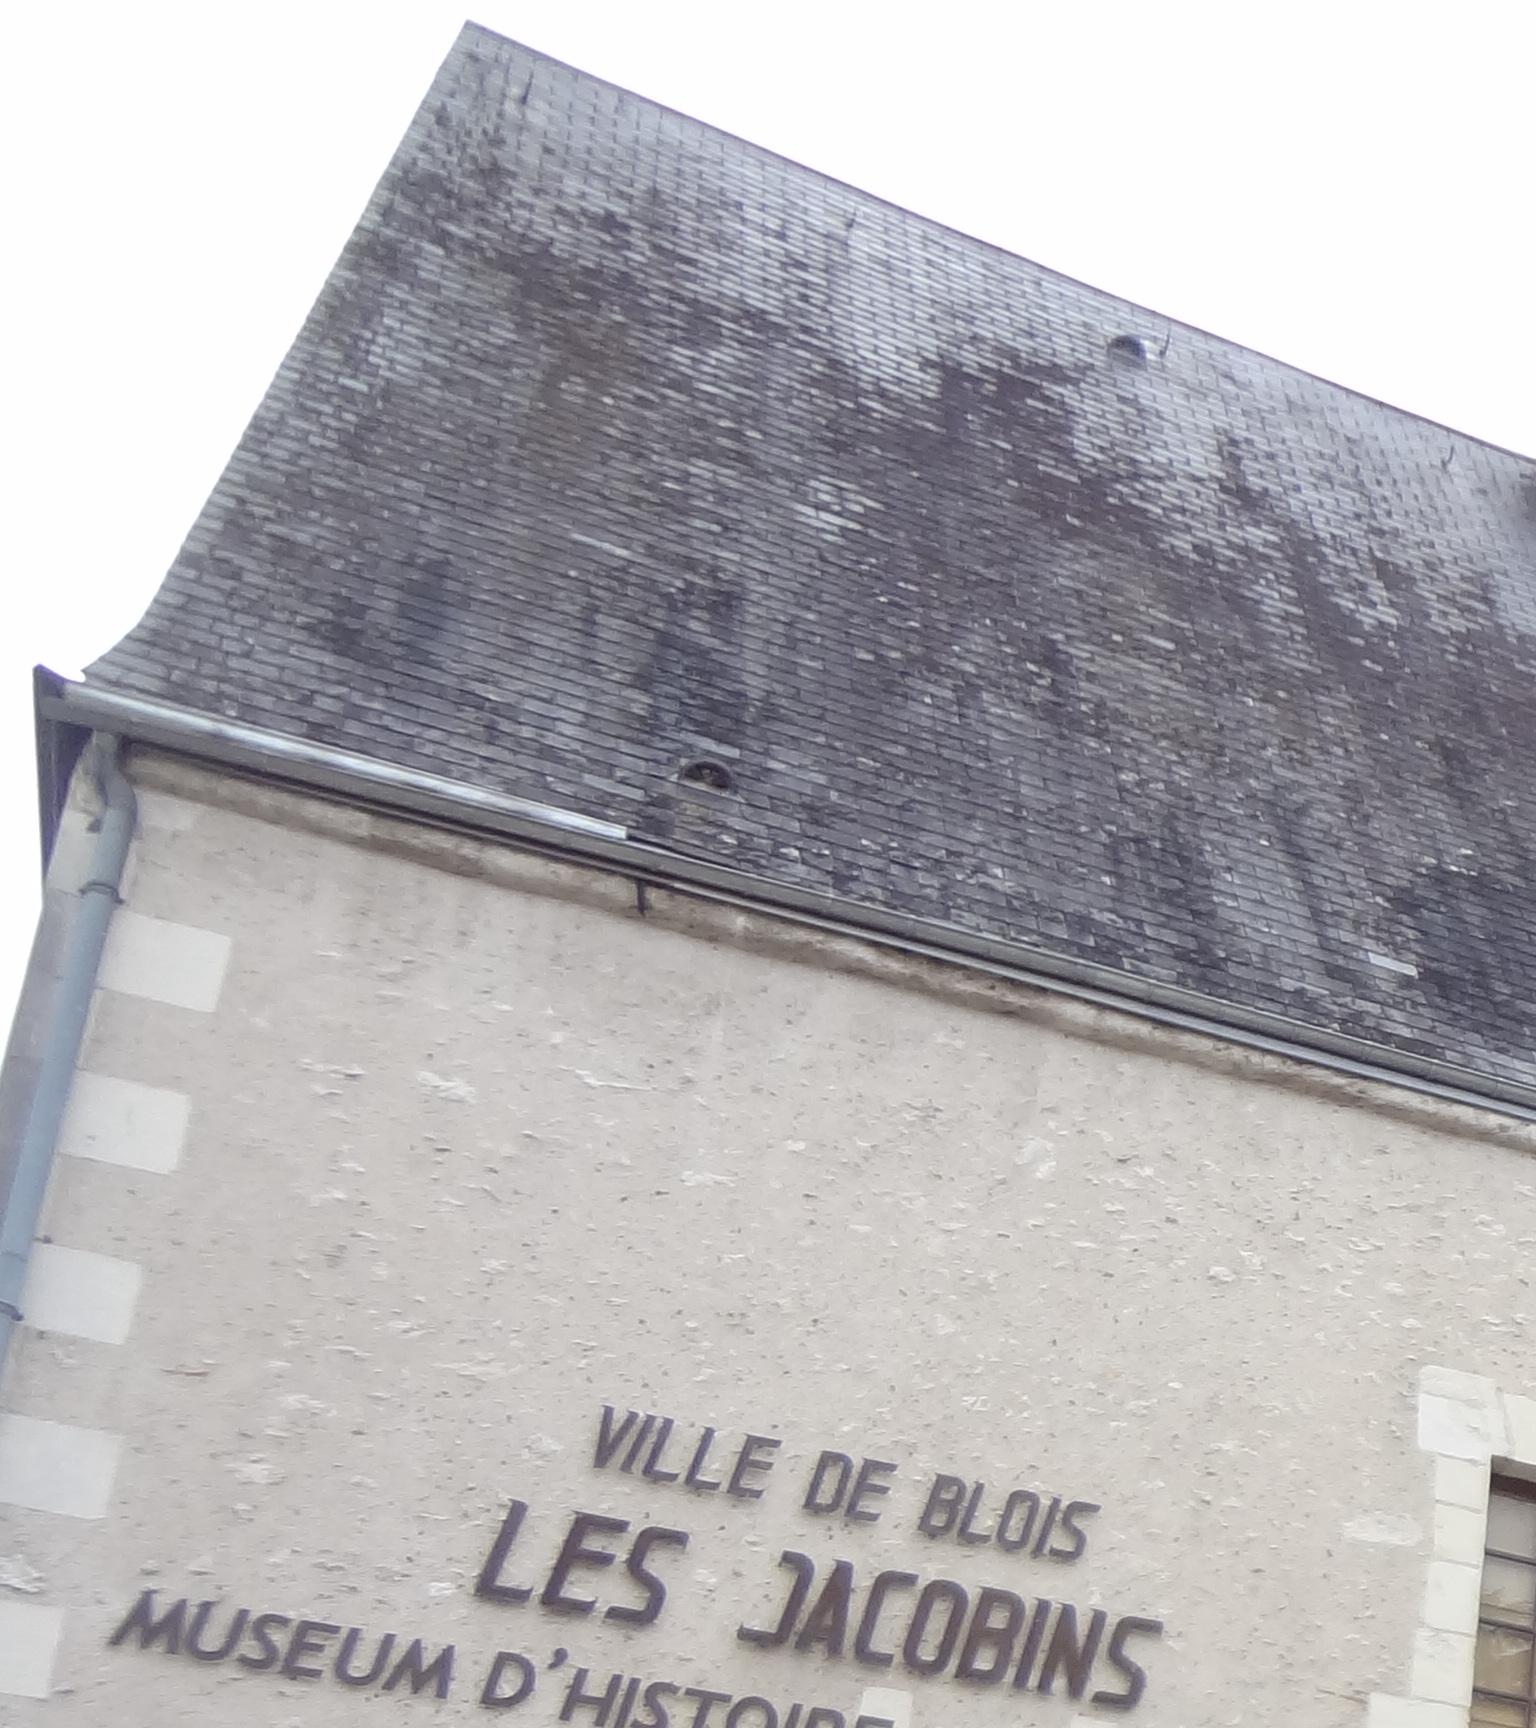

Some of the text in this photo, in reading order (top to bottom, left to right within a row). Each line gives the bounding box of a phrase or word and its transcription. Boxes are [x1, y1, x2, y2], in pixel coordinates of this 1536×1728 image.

[593, 1404, 1101, 1563] VILLE DE BLOIS
[108, 1588, 456, 1700] MUSEUM
[474, 1498, 1164, 1709] LES JACOBINS
